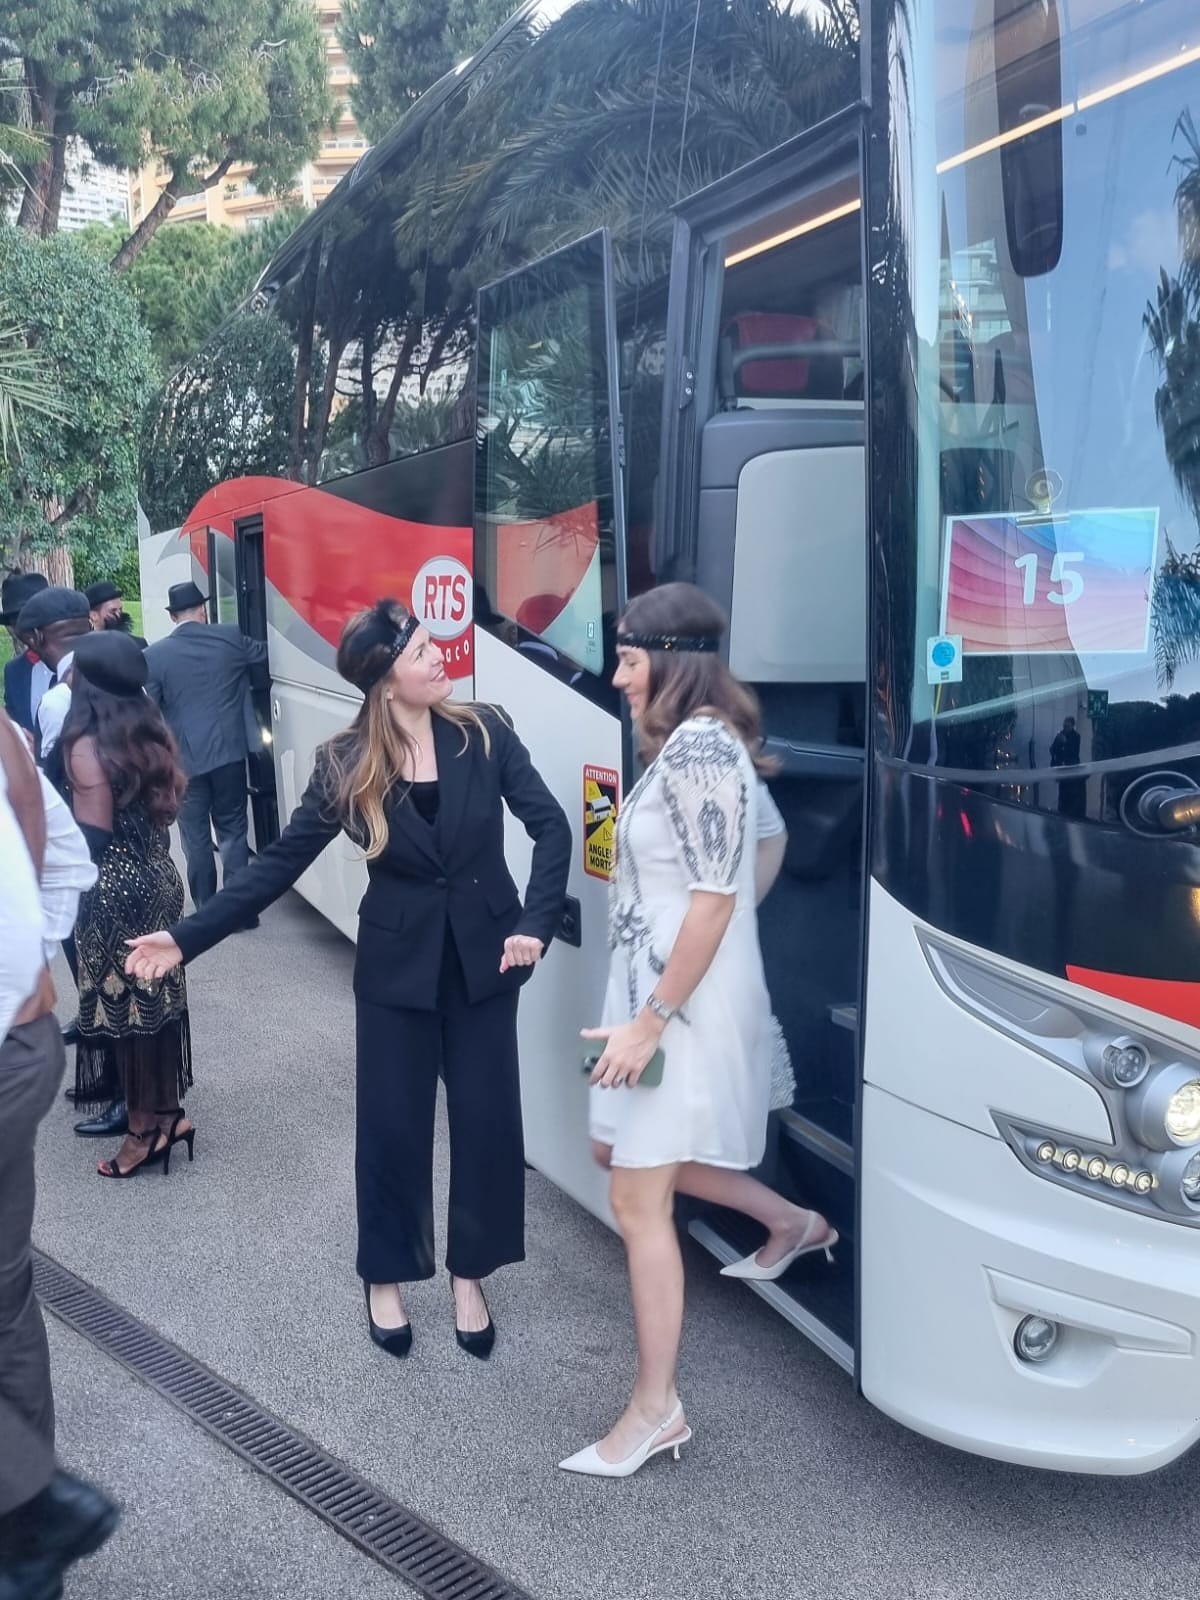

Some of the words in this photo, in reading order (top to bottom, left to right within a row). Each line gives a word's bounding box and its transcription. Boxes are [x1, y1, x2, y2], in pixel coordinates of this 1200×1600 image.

[1014, 551, 1085, 606] 15
[424, 574, 466, 621] RTS
[445, 639, 470, 663] aco
[585, 768, 617, 783] ATTENTION
